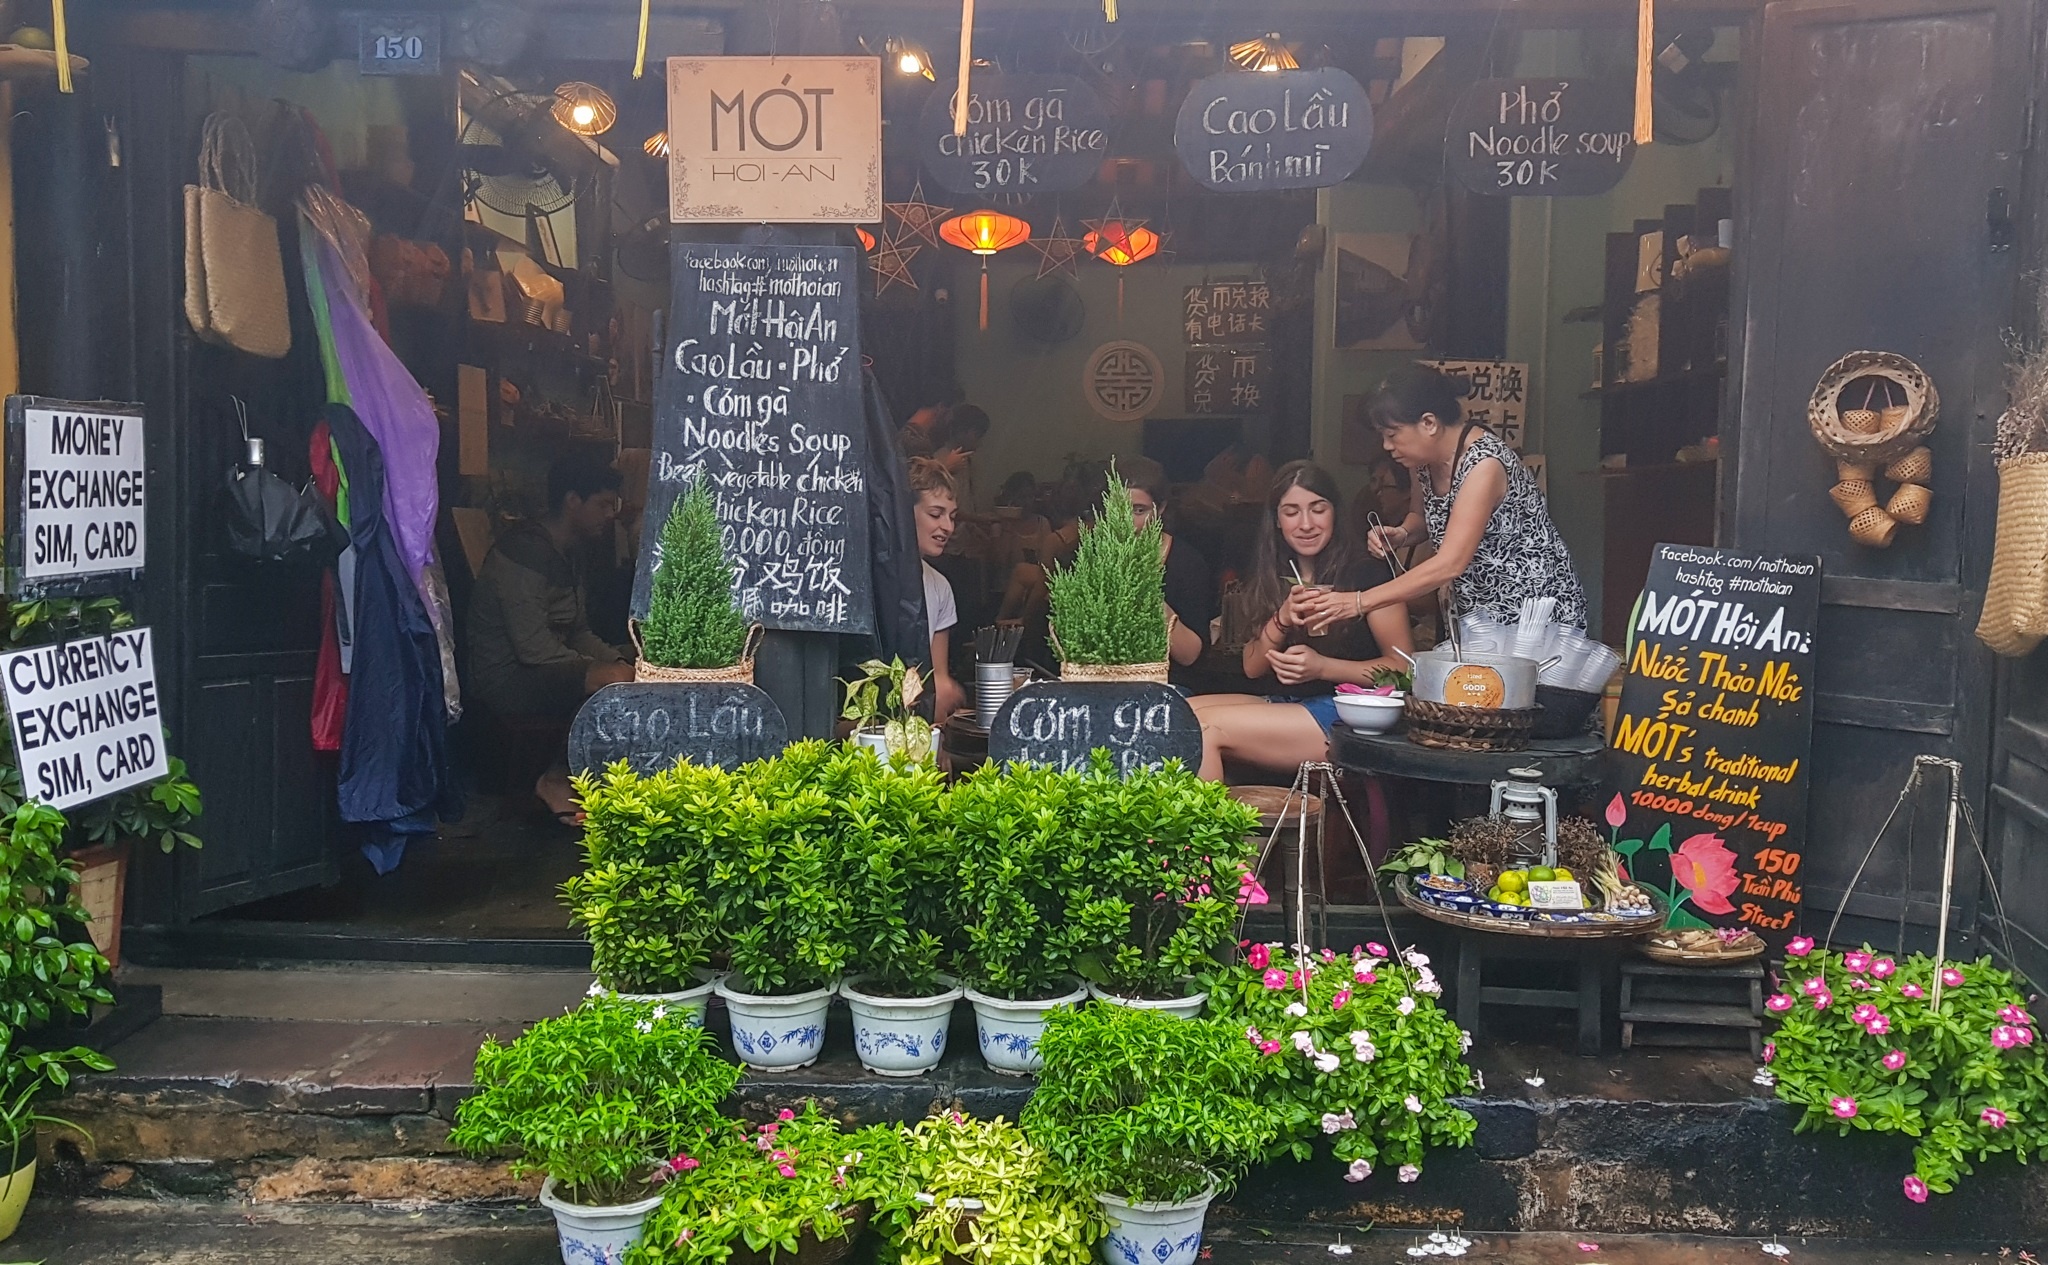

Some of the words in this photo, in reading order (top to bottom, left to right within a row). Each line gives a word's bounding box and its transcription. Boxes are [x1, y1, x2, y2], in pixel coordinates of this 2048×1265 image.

[375, 36, 423, 59] 150
[710, 73, 834, 151] MÓT
[1202, 96, 1277, 135] Cao
[1053, 125, 1106, 155] Rice
[1469, 125, 1570, 158] Noodle
[712, 164, 835, 182] HOI-AN
[804, 302, 838, 342] An
[675, 339, 725, 378] Cao
[51, 415, 124, 456] MONEY
[683, 416, 780, 455] Noodles
[788, 422, 852, 463] Soup
[28, 469, 143, 509] EXCHANGE
[711, 460, 792, 497] vegetable
[714, 491, 787, 528] hicken
[791, 496, 844, 528] Rice
[34, 524, 78, 568] SIM,
[85, 521, 137, 560] CARD
[1660, 547, 1815, 576] facebook.com/mothoian
[1675, 567, 1724, 595] hashtag
[1729, 576, 1794, 596] #mothoian
[1637, 589, 1720, 641] MÓT
[1711, 603, 1761, 650] Hội
[9, 632, 146, 695] CURRENCY
[1698, 651, 1756, 693] Thảo
[1756, 661, 1803, 706] Mộc
[1462, 683, 1486, 692] GOOD
[16, 680, 158, 751] EXCHANGE
[1698, 692, 1760, 727] chanh
[38, 752, 92, 801] SIM,
[96, 733, 156, 783] CARD
[1703, 747, 1799, 784] traditional
[1641, 763, 1714, 798] herbal
[1708, 778, 1762, 810] drink
[1753, 848, 1801, 875] 150
[1738, 903, 1795, 930] Street
